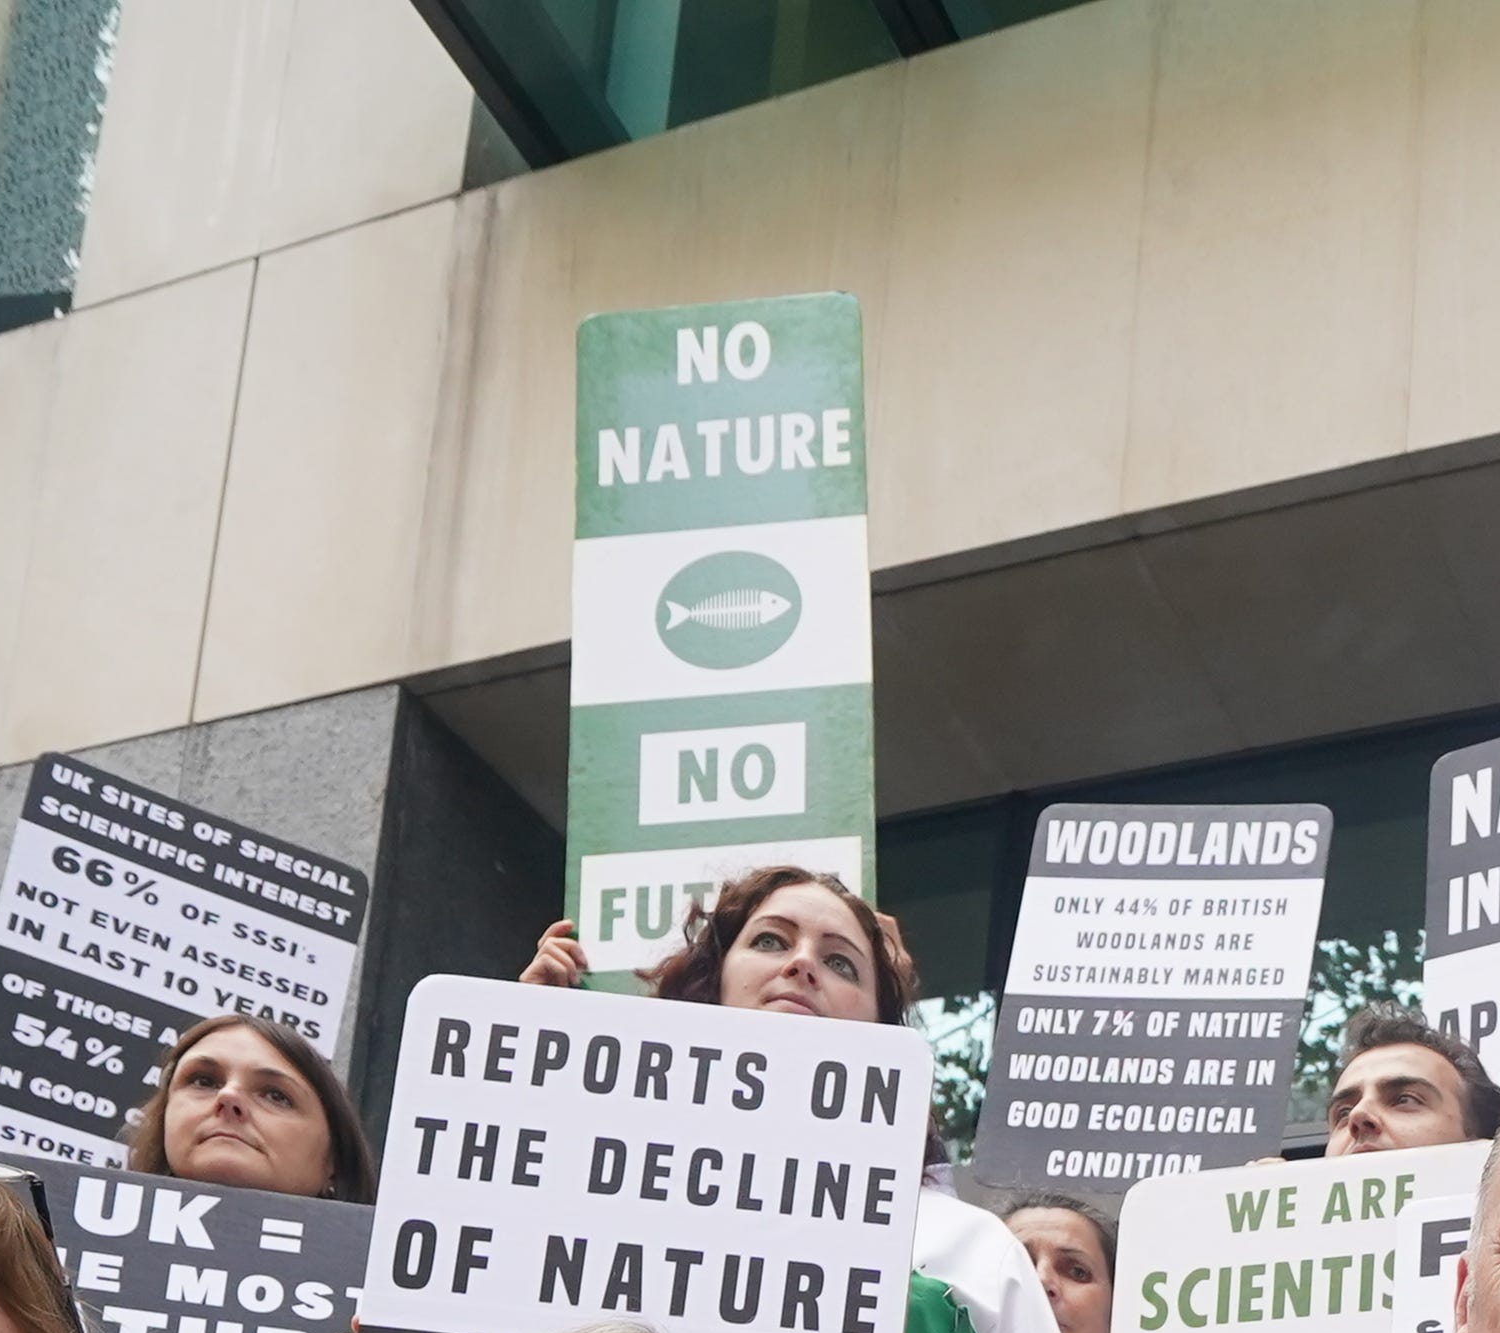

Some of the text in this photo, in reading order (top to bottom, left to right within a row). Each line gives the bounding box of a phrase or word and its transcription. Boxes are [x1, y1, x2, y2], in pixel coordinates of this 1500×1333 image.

[677, 321, 770, 385] NO
[598, 408, 851, 486] NATURE
[677, 743, 776, 804] NO
[51, 764, 355, 896] UK SITES OF SPECIAL
[1044, 819, 1319, 866] WOODLANDS
[40, 796, 352, 926] SCIENTIFIC INTEREST
[51, 845, 221, 926] 66% OF
[1054, 896, 1288, 916] ONLY 44% OF BRITISH
[1447, 874, 1500, 935] IN
[15, 881, 329, 1006] NOT EVEN ASSESSED
[1076, 931, 1254, 951] WOODLANDS ARE
[1032, 963, 1285, 986] SUSTAINABLY MANAGED
[1017, 1008, 1283, 1039] ONLY 7% OF NATIVE
[430, 1016, 901, 1127] REPORTS ON
[1008, 1054, 1274, 1085] WOODLANDS ARE IN
[1008, 1099, 1257, 1133] GOOD ECOLOGICAL
[412, 1116, 896, 1226] THE DECLINE
[1046, 1150, 1201, 1177] CONDITION
[70, 1179, 220, 1251] UK
[1225, 1173, 1415, 1234] WE ARE
[391, 1218, 492, 1295] OF
